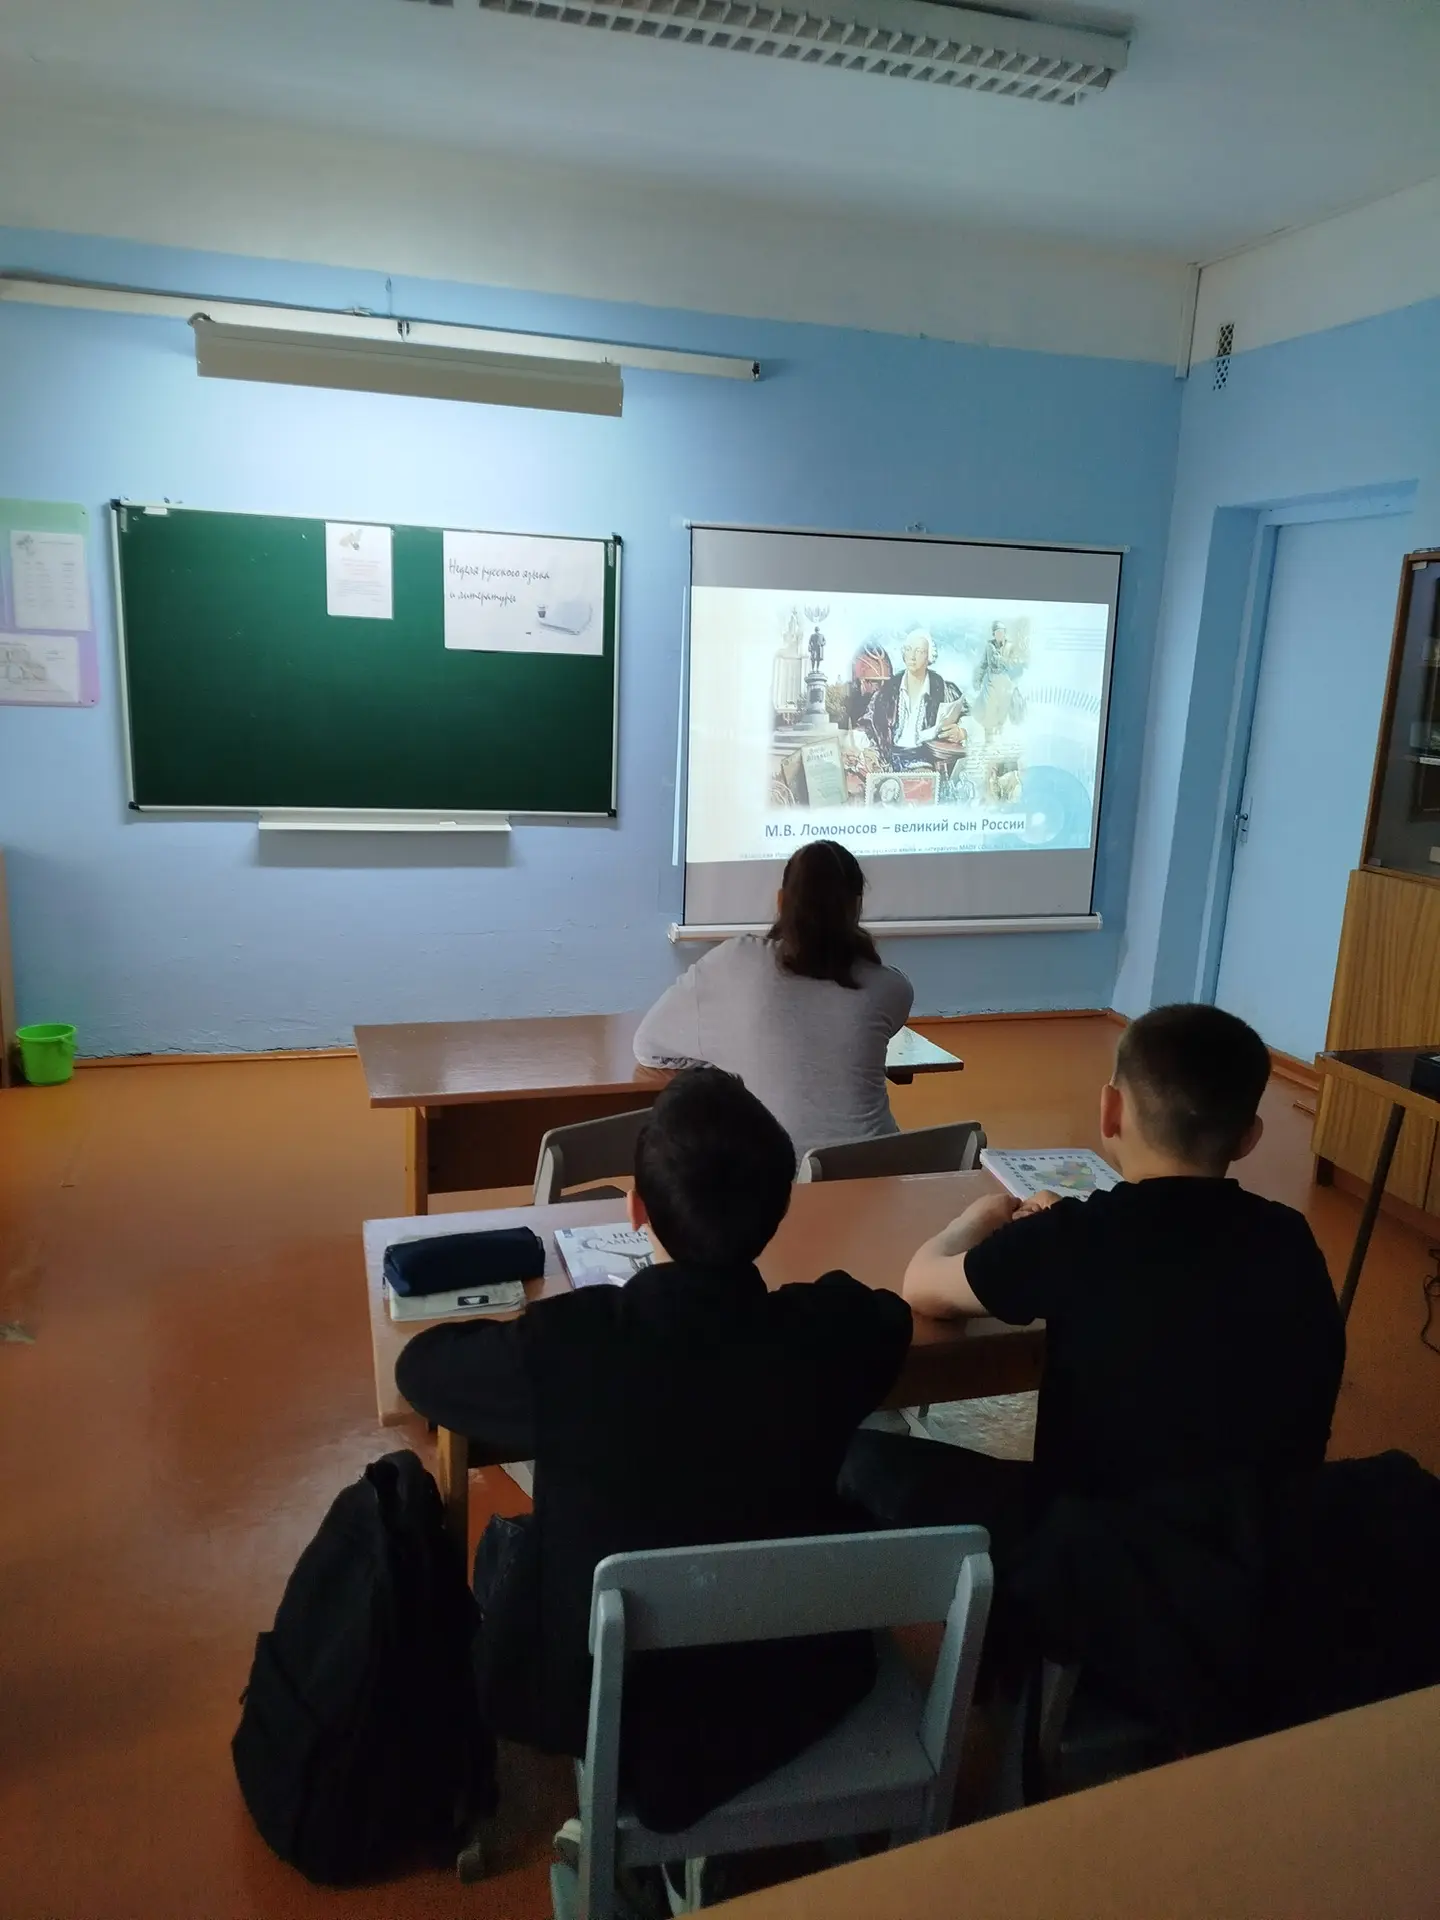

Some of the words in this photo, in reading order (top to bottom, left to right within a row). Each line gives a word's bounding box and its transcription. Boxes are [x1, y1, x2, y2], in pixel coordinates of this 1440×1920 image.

[449, 558, 479, 580] Неделя
[481, 565, 520, 582] русского
[522, 569, 550, 585] языка
[458, 591, 516, 608] литературы
[765, 824, 796, 837] М.В.
[800, 822, 877, 837] Ломоносов
[894, 819, 949, 833] великий
[953, 821, 977, 832] сын
[981, 818, 1025, 831] России
